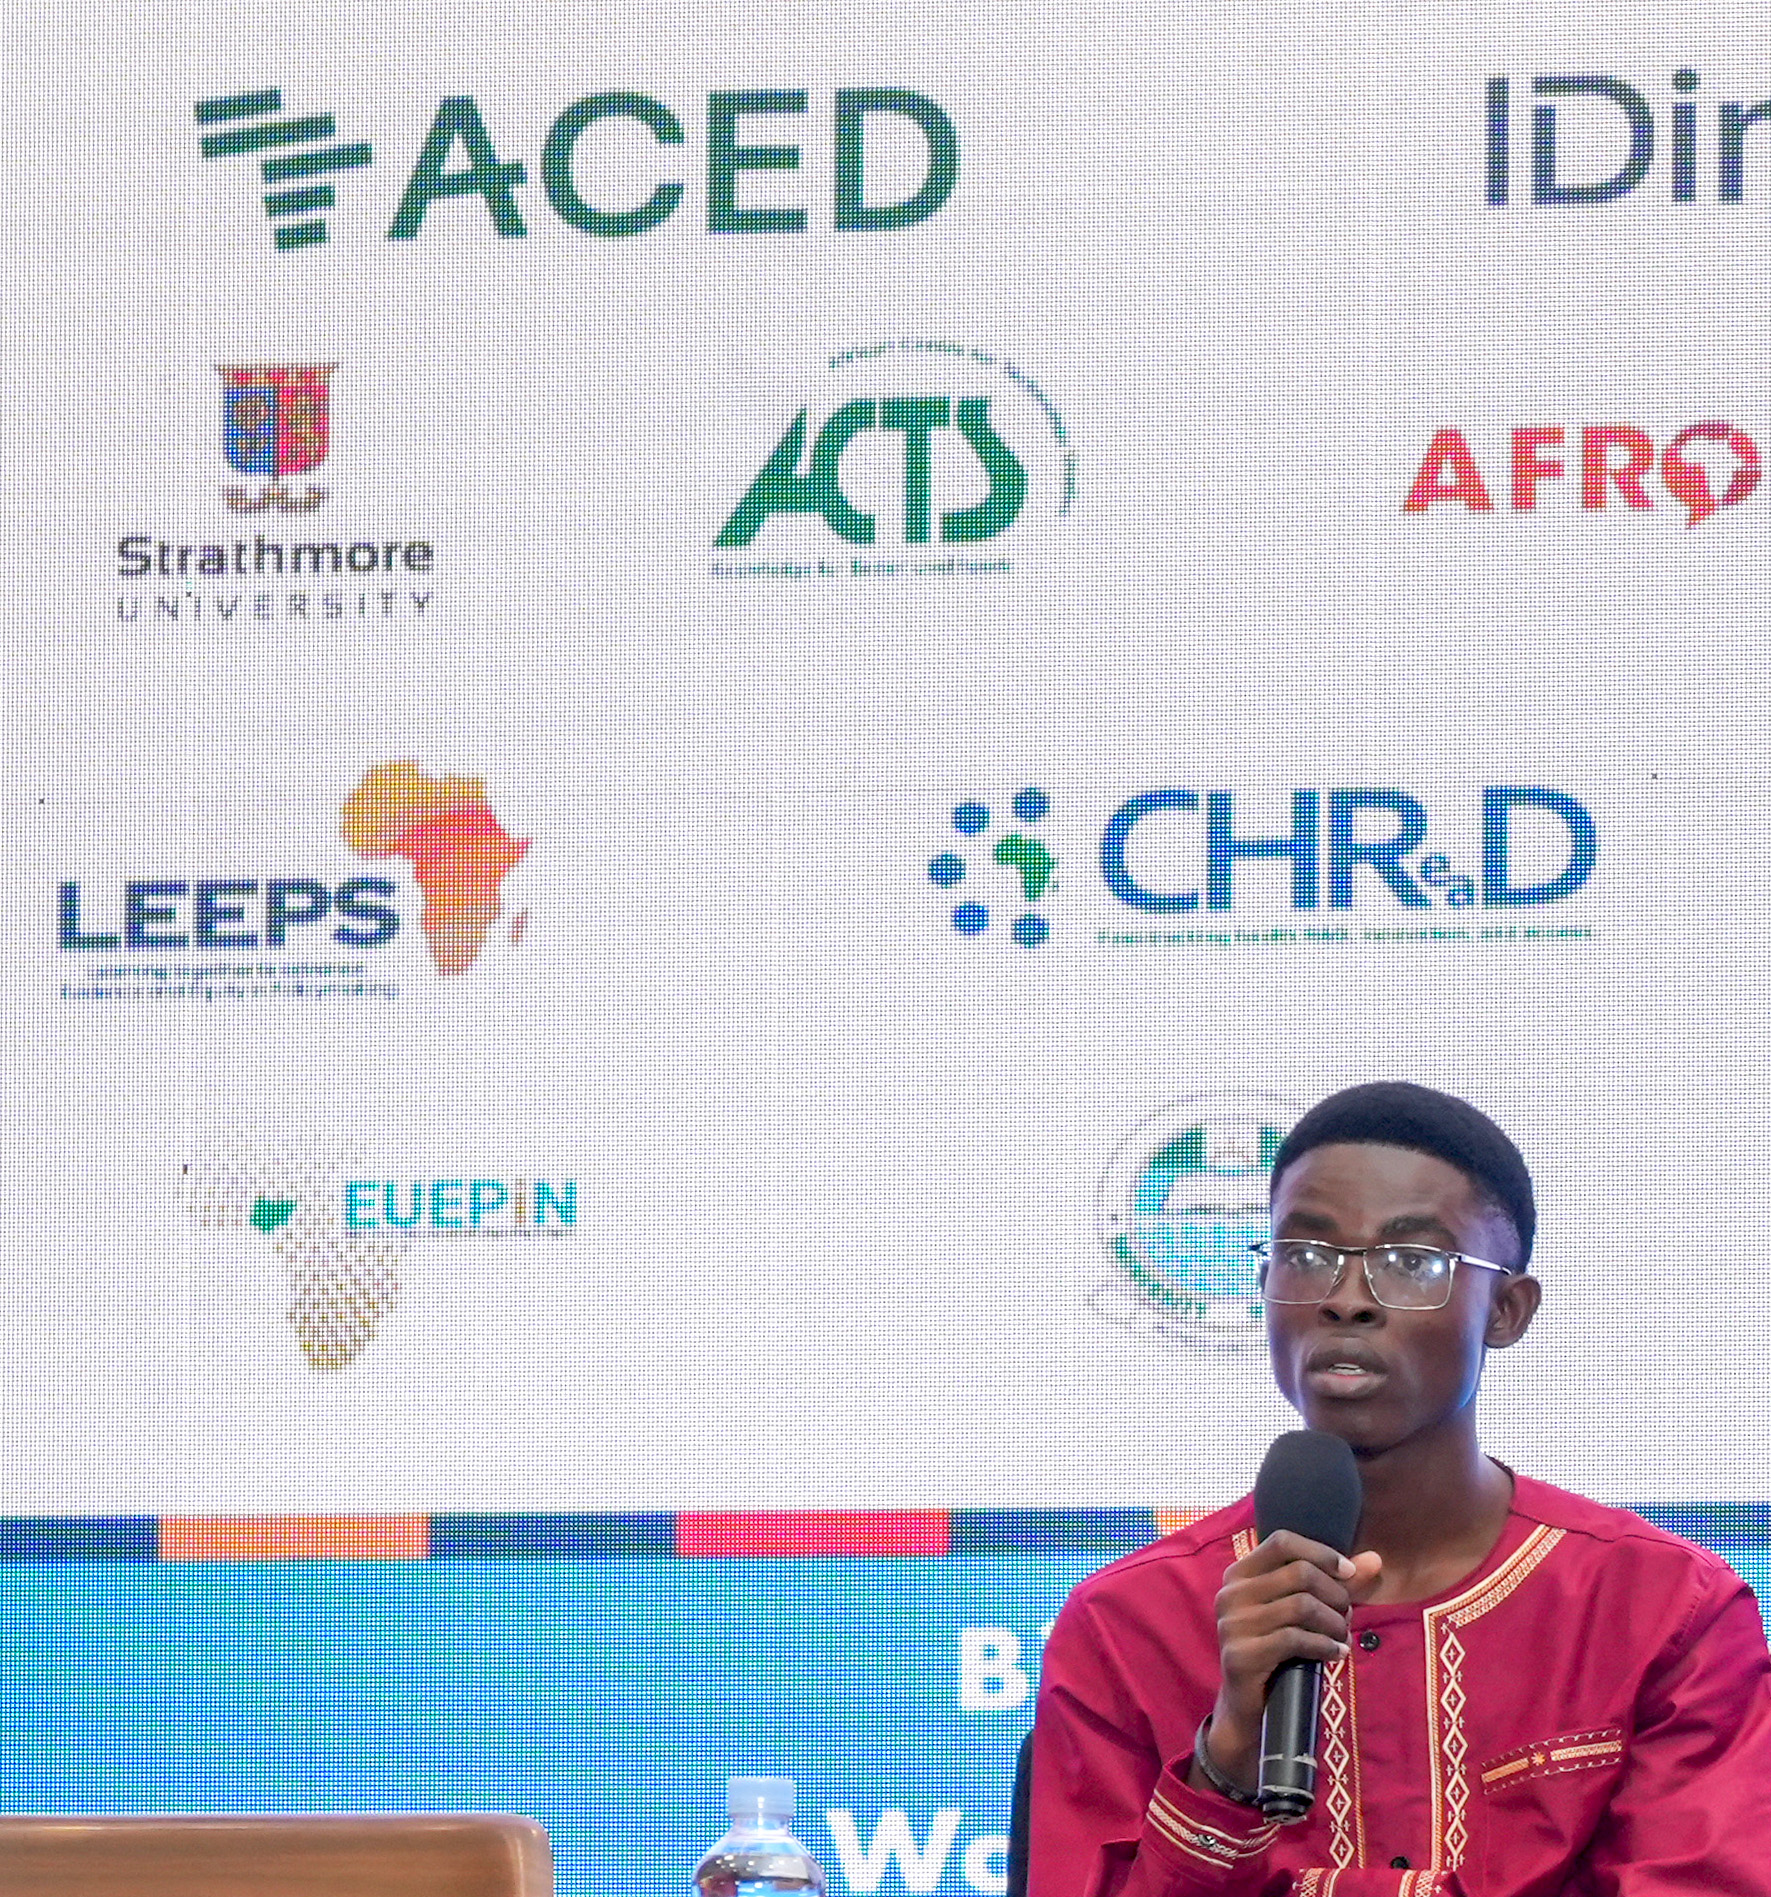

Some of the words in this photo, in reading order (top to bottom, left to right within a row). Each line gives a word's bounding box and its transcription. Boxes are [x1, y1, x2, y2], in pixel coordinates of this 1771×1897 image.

[386, 86, 962, 241] ACED
[712, 395, 1028, 548] ACTS
[115, 531, 434, 578] Strathmore
[114, 590, 434, 622] UNIVERSITY
[58, 877, 401, 951] LEEPS
